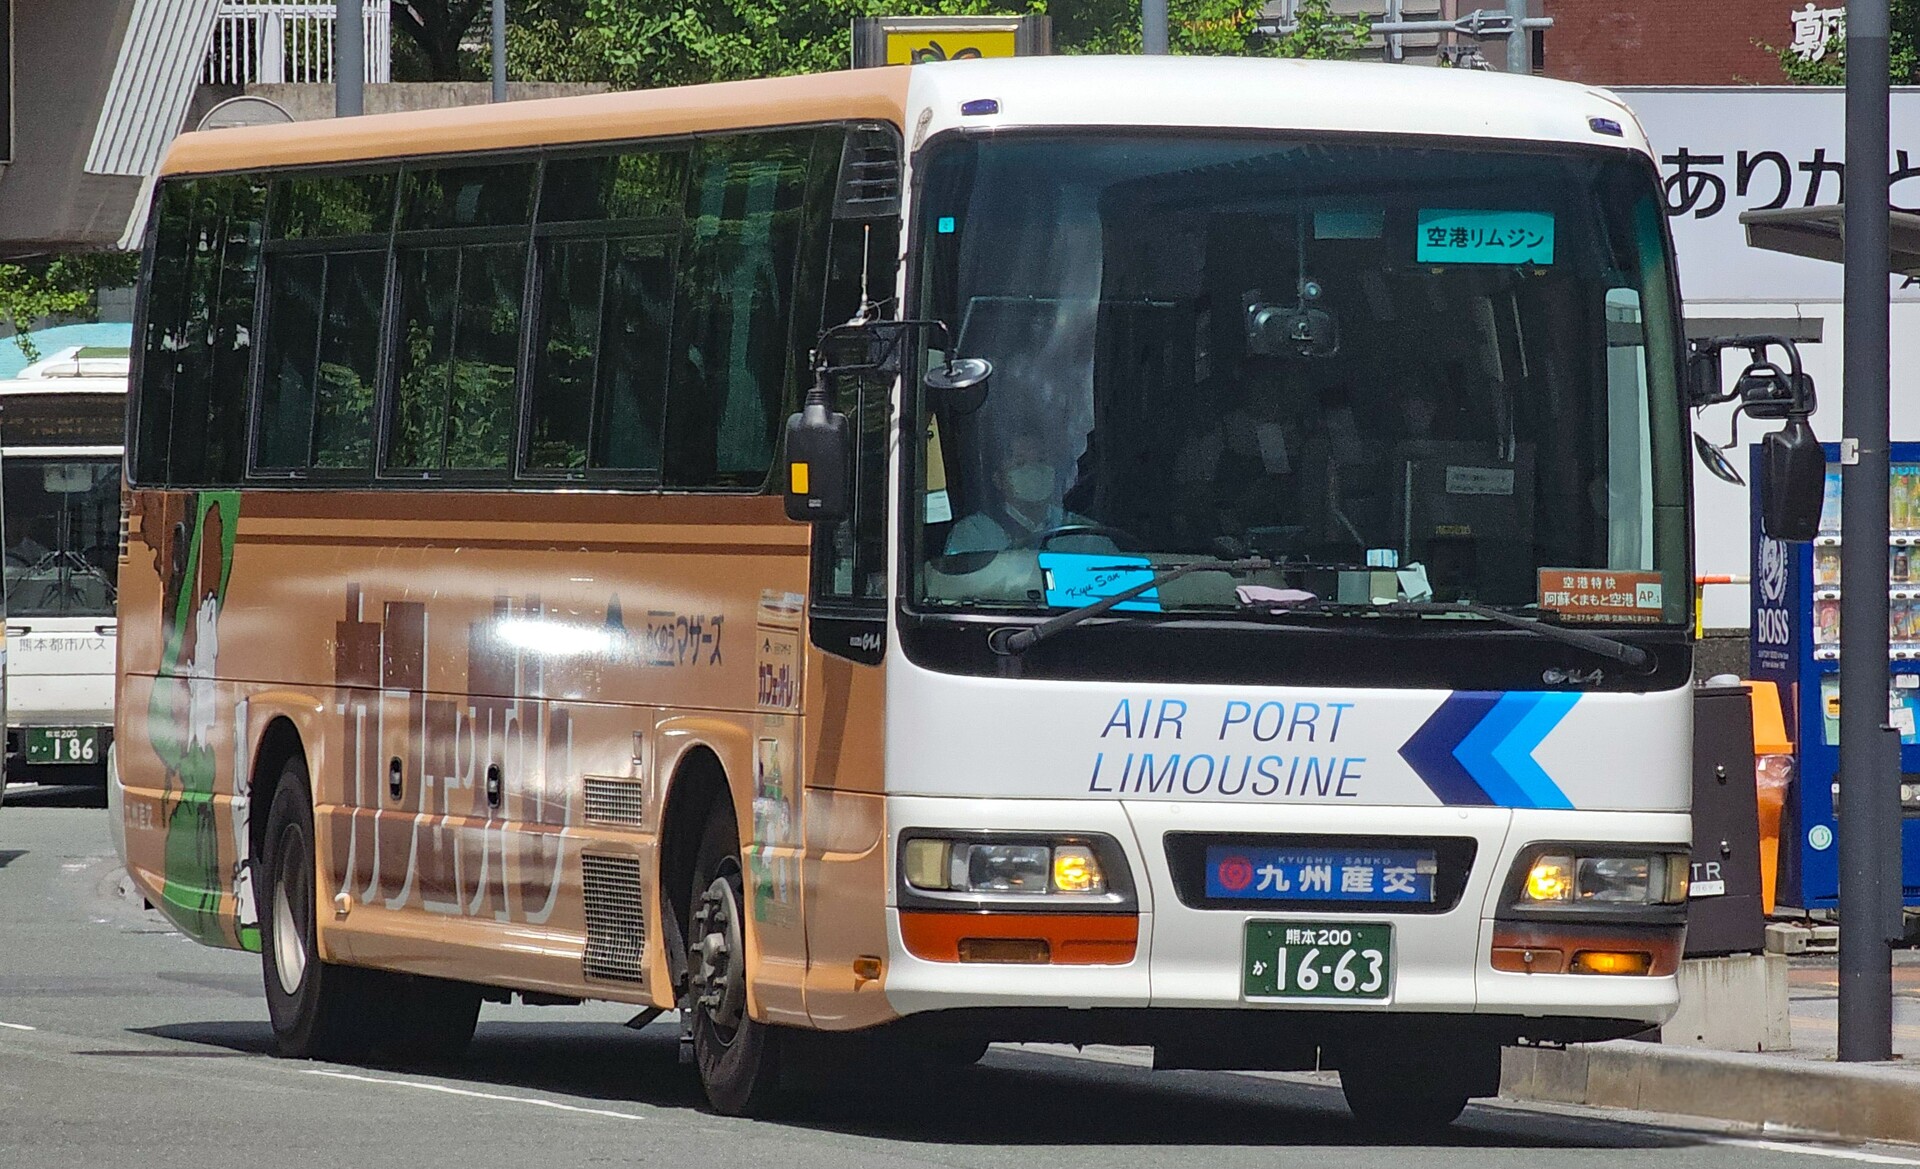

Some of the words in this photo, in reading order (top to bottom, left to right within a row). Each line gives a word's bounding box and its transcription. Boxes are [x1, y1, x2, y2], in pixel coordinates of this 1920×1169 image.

[1427, 226, 1544, 248] 空港リムジン
[1095, 572, 1120, 587] San
[1563, 576, 1616, 590] 空港特快
[1544, 592, 1633, 607] 阿蘇くまもと空港
[1757, 608, 1789, 645] BOSS
[19, 637, 107, 652] 熊本都市バス
[1100, 699, 1188, 740] AIR
[1218, 701, 1355, 743] PORT
[1088, 752, 1367, 797] LIMOUSINE
[1278, 855, 1333, 864] KYUSHU
[1345, 856, 1392, 865] SANKO
[1256, 864, 1417, 894] 九州産交
[1285, 928, 1352, 945] 熊本200
[1252, 960, 1268, 976] か
[1277, 946, 1384, 993] 16-63
